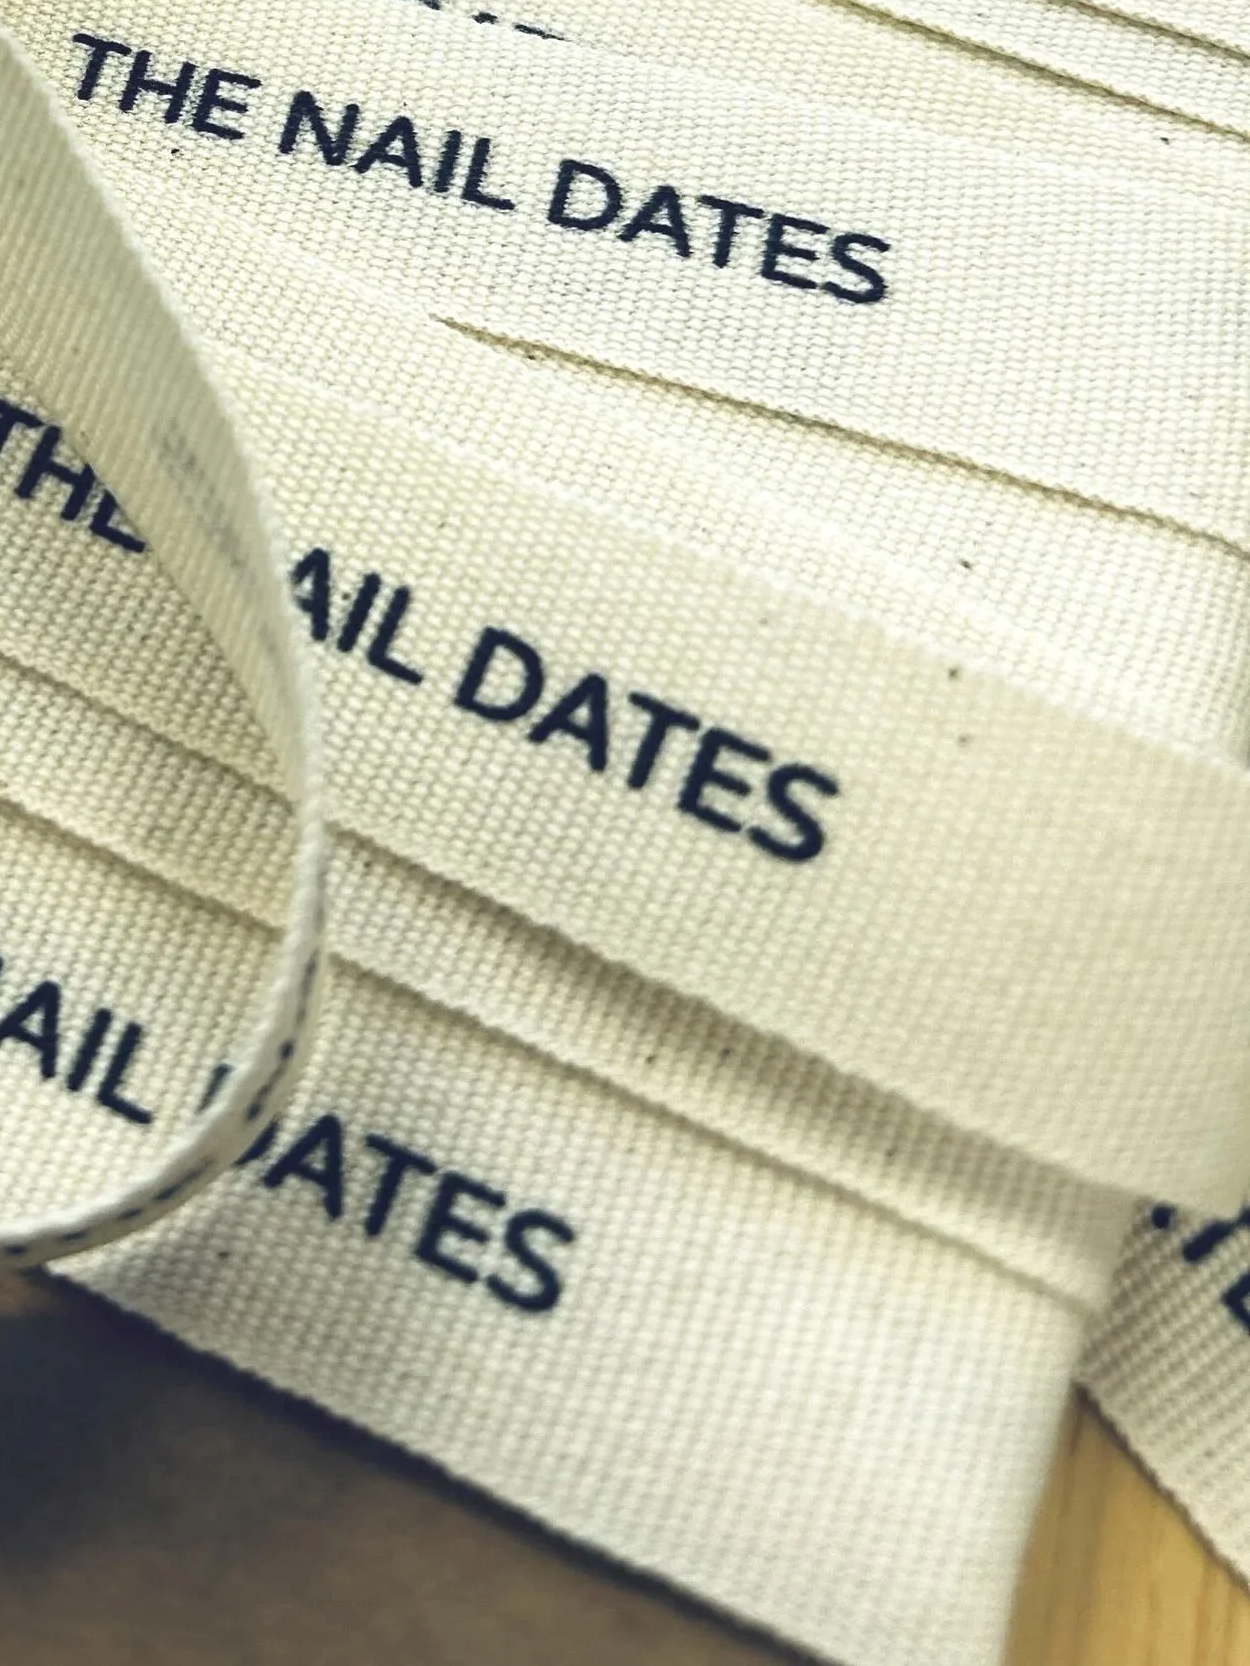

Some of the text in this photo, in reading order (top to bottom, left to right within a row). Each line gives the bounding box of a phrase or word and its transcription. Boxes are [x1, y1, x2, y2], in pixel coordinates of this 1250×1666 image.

[72, 32, 892, 306] THE NAIL DATES
[290, 547, 425, 685] AIL
[451, 625, 840, 865] DATES
